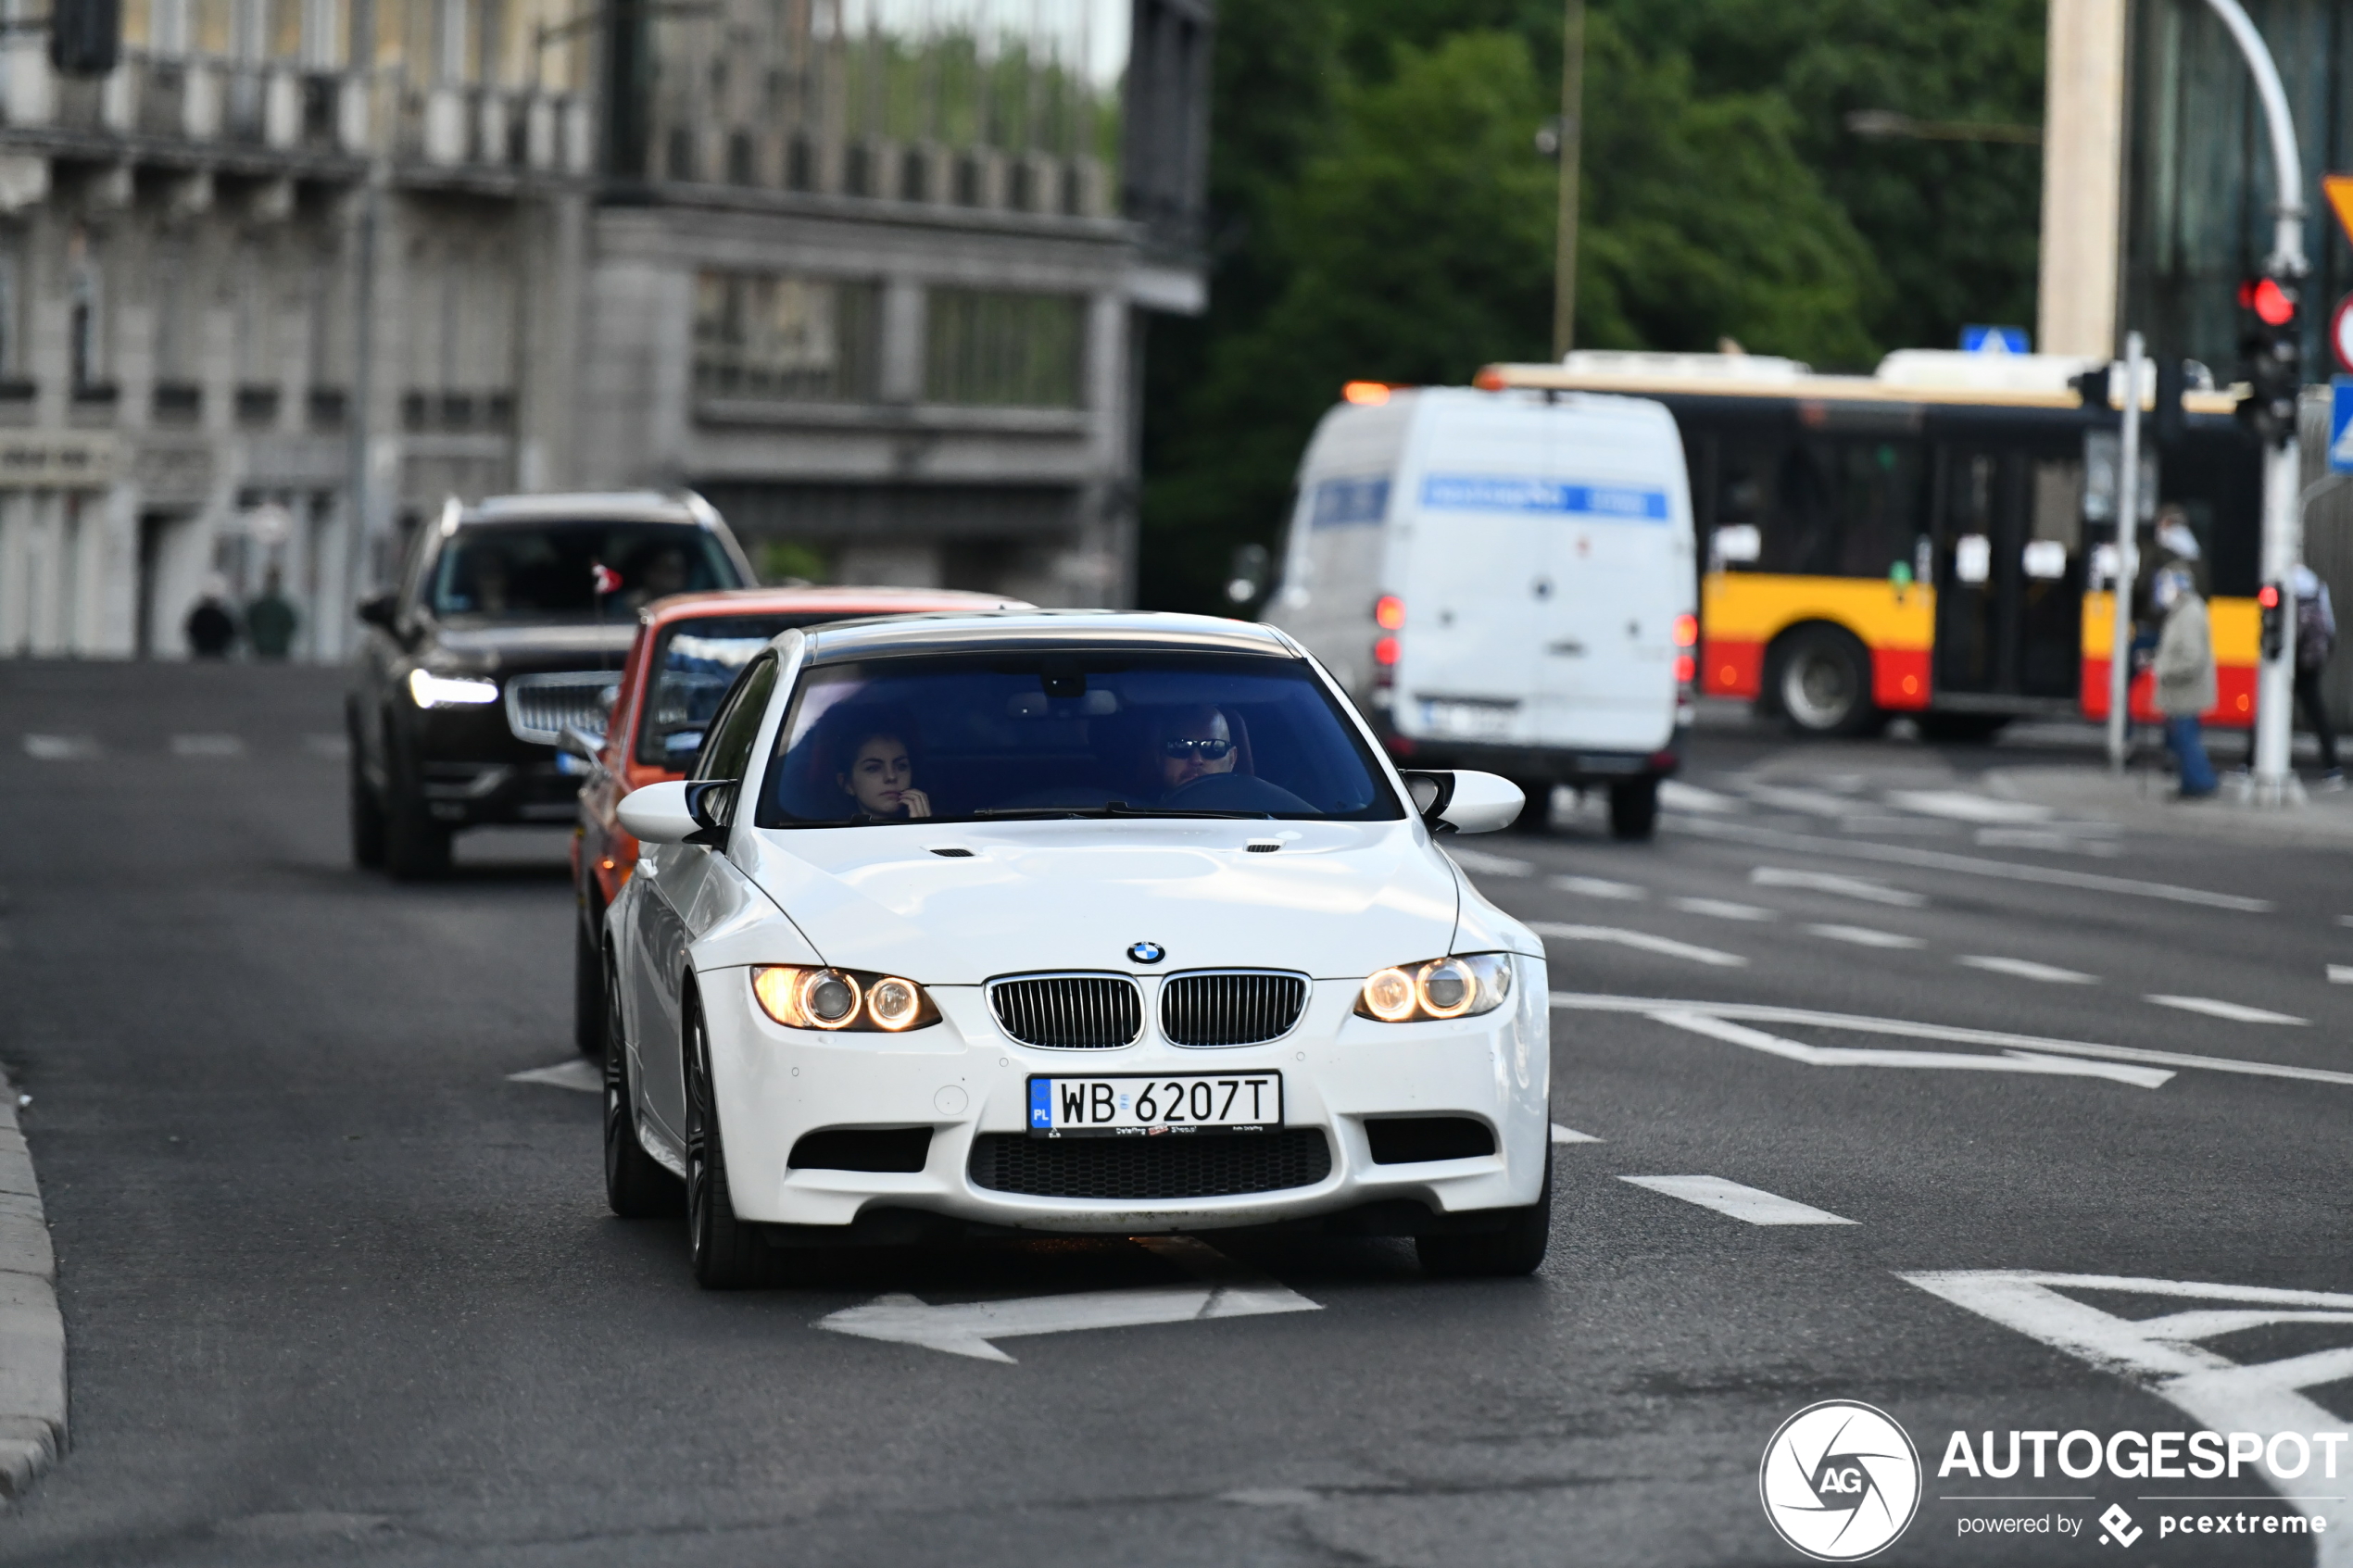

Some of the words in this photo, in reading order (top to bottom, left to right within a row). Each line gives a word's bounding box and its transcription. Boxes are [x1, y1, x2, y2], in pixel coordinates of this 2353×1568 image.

[1061, 1083, 1115, 1123] WB
[1135, 1079, 1268, 1123] 6207T
[1033, 1109, 1050, 1122] PL
